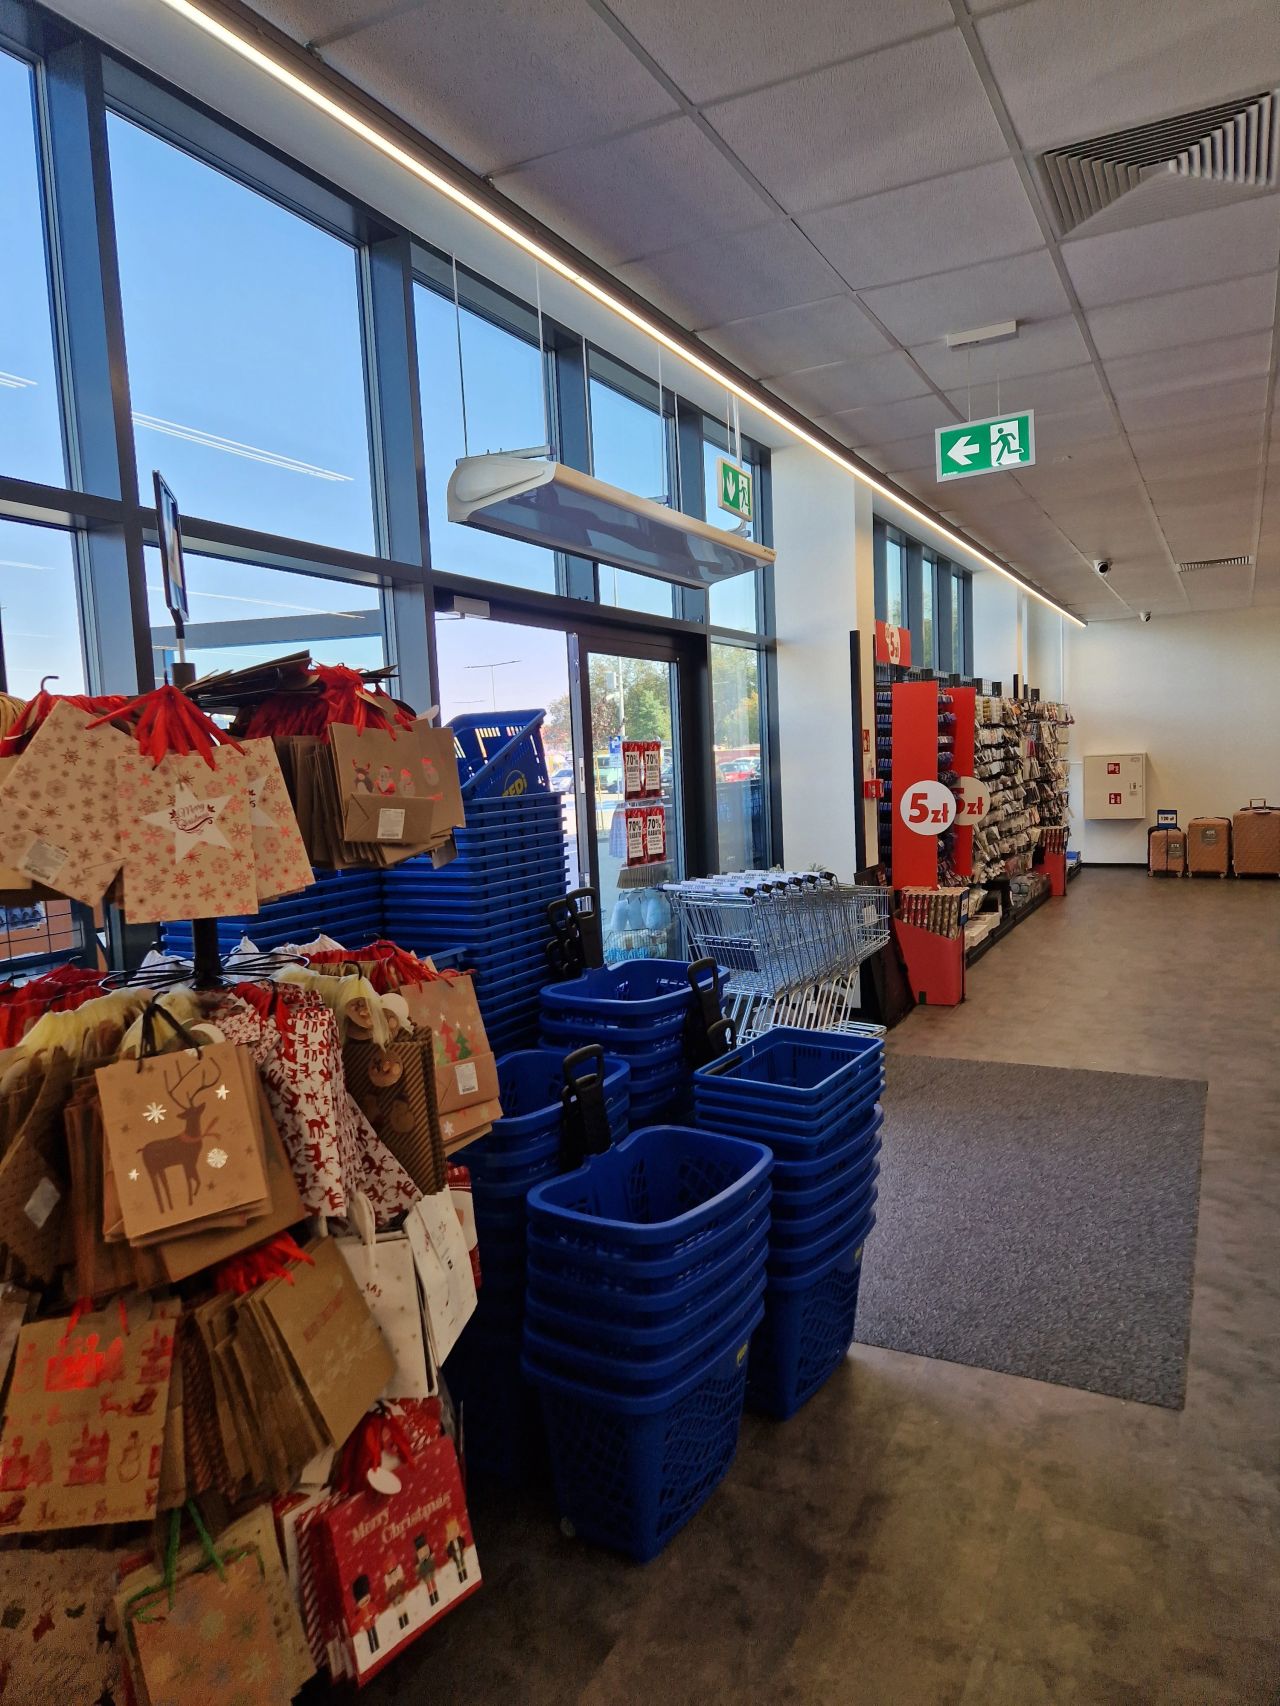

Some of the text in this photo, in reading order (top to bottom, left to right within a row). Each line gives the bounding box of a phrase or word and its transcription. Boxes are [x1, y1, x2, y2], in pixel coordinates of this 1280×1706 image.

[646, 753, 658, 765] 70%
[647, 818, 662, 830] 70%
[351, 1506, 390, 1547] Merry
[381, 1489, 453, 1545] Christmas
